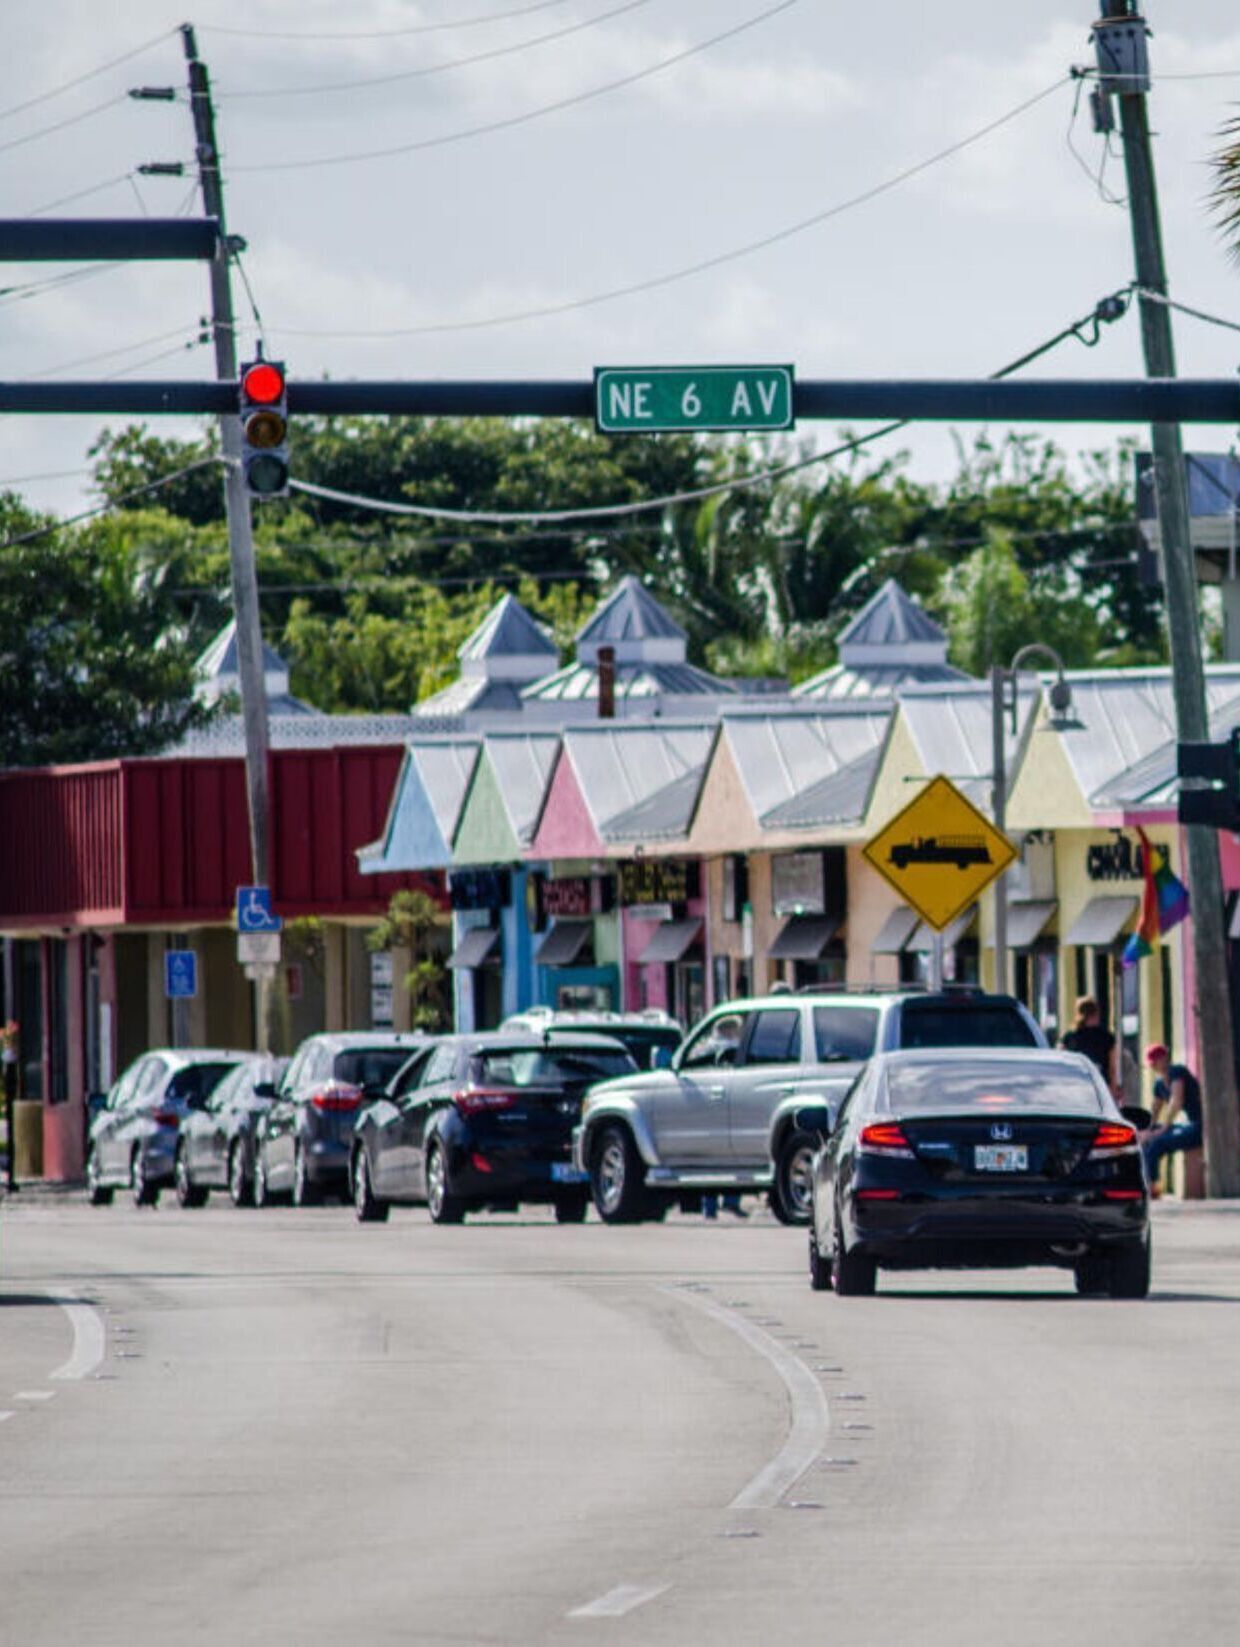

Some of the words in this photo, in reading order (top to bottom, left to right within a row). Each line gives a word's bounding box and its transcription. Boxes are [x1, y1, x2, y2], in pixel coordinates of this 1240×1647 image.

[609, 382, 652, 419] NE
[681, 382, 701, 417] 6
[731, 380, 777, 416] AV
